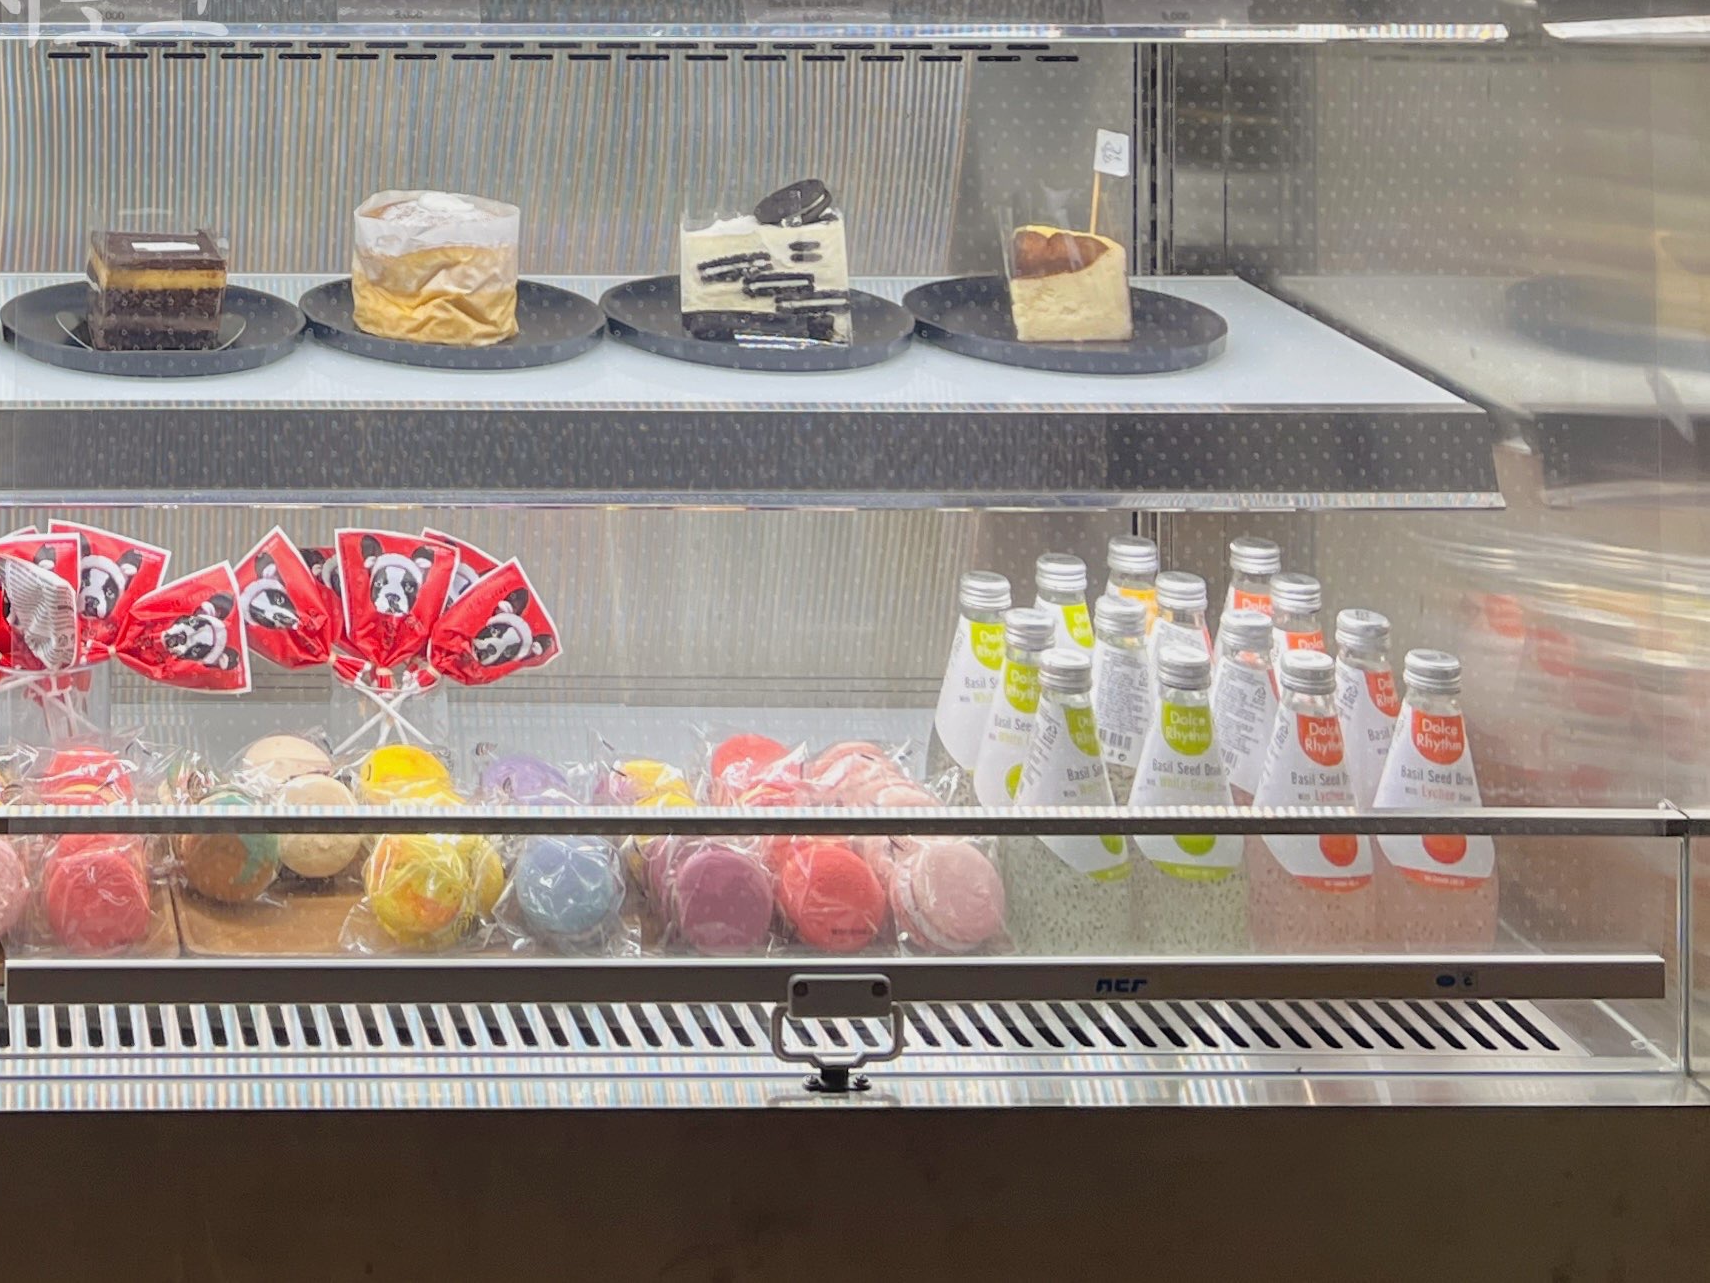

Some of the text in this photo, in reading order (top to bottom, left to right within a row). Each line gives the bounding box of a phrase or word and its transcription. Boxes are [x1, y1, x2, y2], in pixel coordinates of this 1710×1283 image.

[980, 629, 1005, 642] Dol
[1297, 637, 1324, 650] Dolc
[1011, 670, 1040, 685] Dolc
[1014, 718, 1033, 731] See
[1422, 718, 1459, 736] Dolce
[1416, 732, 1462, 753] Rhythm
[1177, 761, 1201, 776] Seed
[1401, 765, 1424, 780] Basil
[1428, 769, 1452, 785] Seed
[1291, 771, 1316, 786] Basil
